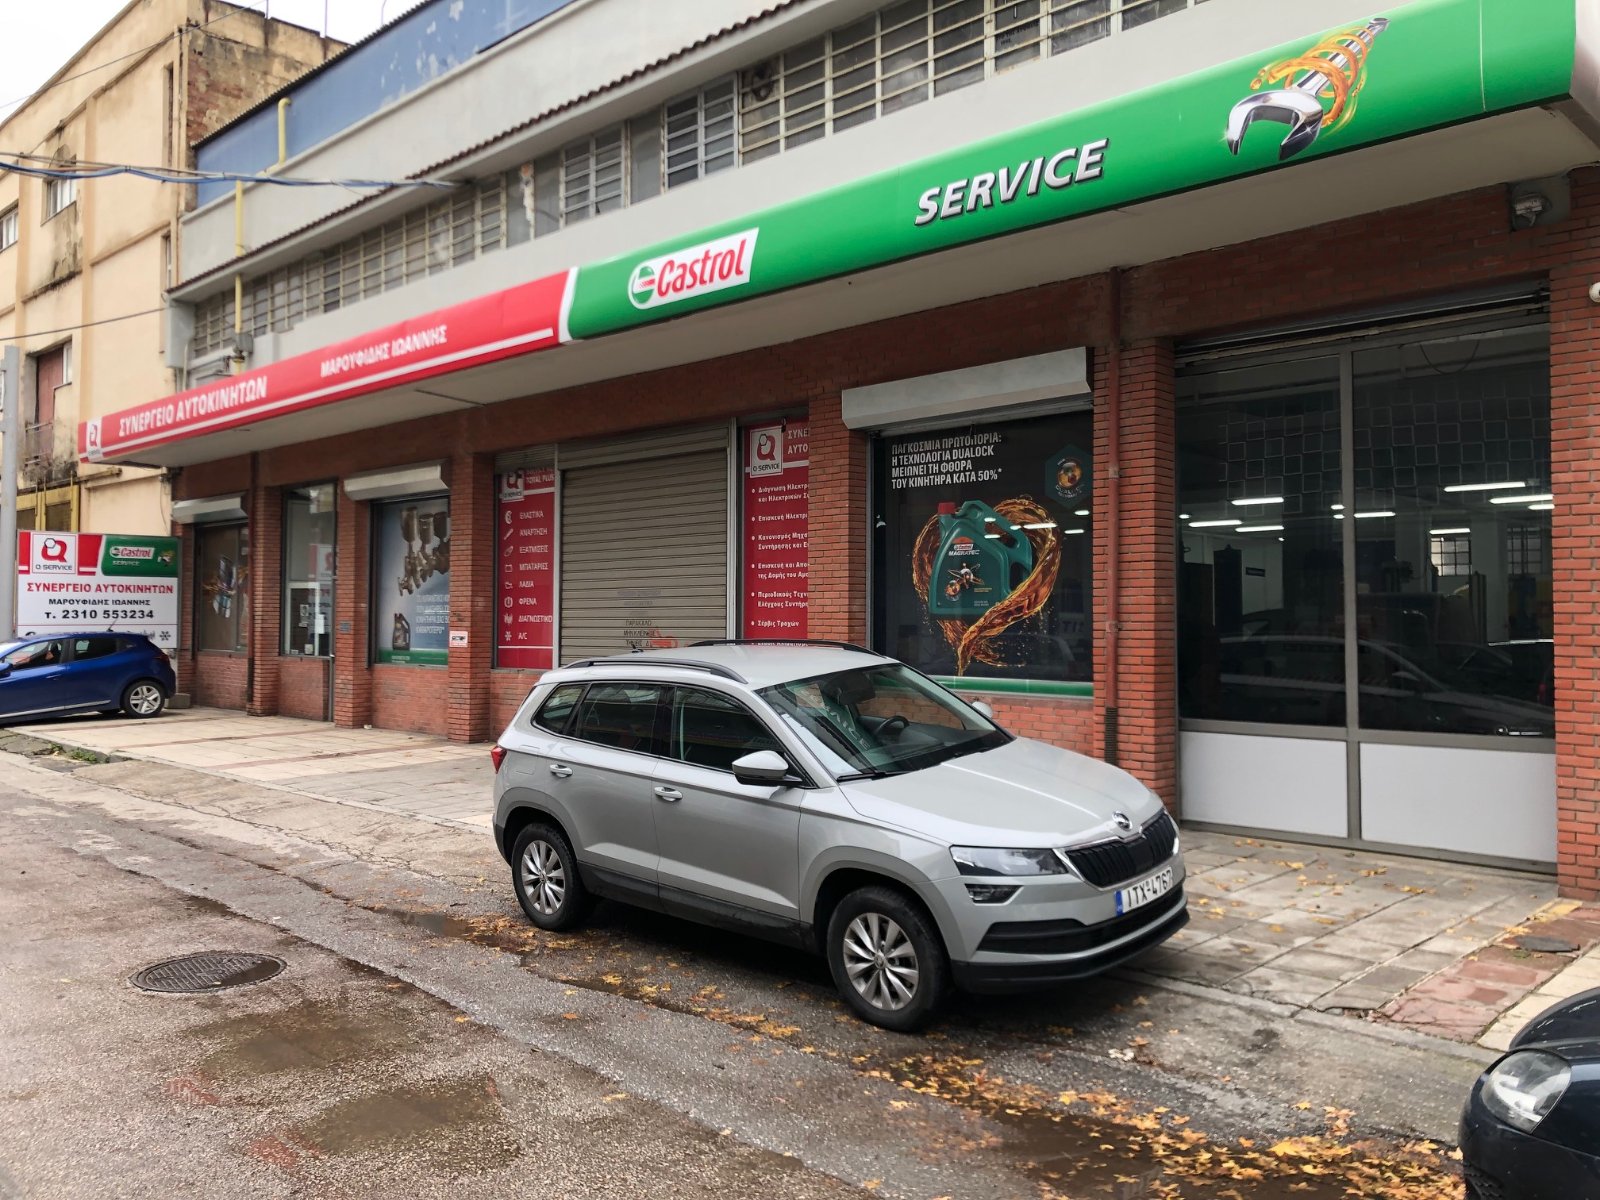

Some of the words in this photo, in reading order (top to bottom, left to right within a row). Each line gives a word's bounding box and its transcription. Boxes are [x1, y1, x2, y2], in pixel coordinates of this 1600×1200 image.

[914, 138, 1109, 226] SERVICE
[657, 239, 747, 297] Castrol
[320, 342, 390, 378] ΜΑΡΟΥΦΙΔΗΣ
[391, 324, 447, 357] ΙΩΑΝΝΗΣ
[118, 403, 174, 437] ΣΥΝΕΡΓΕΙΟ
[176, 376, 267, 421] ΑΥΤΟΚΙΝΗΤΩΝ
[787, 443, 808, 455] ΑΥΤΟ
[892, 439, 941, 455] ΠΑΓΚΟΣΜΙΑ
[892, 456, 898, 466] Η
[899, 450, 951, 465] ΤΕΧΝΟΛΟΓΙΑ
[952, 445, 994, 460] DUALOCK
[759, 463, 780, 472] SERVICE
[892, 464, 927, 478] ΜΕΙΩΝΕΙ
[928, 463, 939, 474] ΤΗ
[940, 459, 972, 473] ΦΘΟΡΑ
[891, 478, 907, 489] ΤΟΥ
[908, 474, 952, 488] ΚΙΝΗΤΗΡΑ
[953, 471, 976, 484] ΚΑΤΑ
[758, 485, 786, 494] Διάγνωση
[787, 483, 809, 491] Ηλεκτρ
[768, 492, 802, 502] Ηλεκτρικών
[120, 547, 152, 558] Castrol
[519, 562, 549, 571] ΜΠΑΤΑΡΙΕΣ
[27, 583, 92, 593] ΣΥΝΕΡΓΕΙΟ
[95, 583, 173, 594] ΑΥΤΟΚΙΝΗΤΩΝ
[519, 580, 534, 588] ΛΑΔΙΑ
[48, 598, 109, 606] ΜΑΡΟΥΦΙΔΗΣ
[112, 598, 151, 606] ΙΩΑΝΝΗΣ
[518, 597, 537, 605] ΦΡΕΝΑ
[62, 609, 97, 619] 2310
[102, 609, 154, 619] 553234
[757, 620, 776, 628] Σέρβις
[776, 620, 800, 628] Τροχών
[518, 632, 528, 640] A/C
